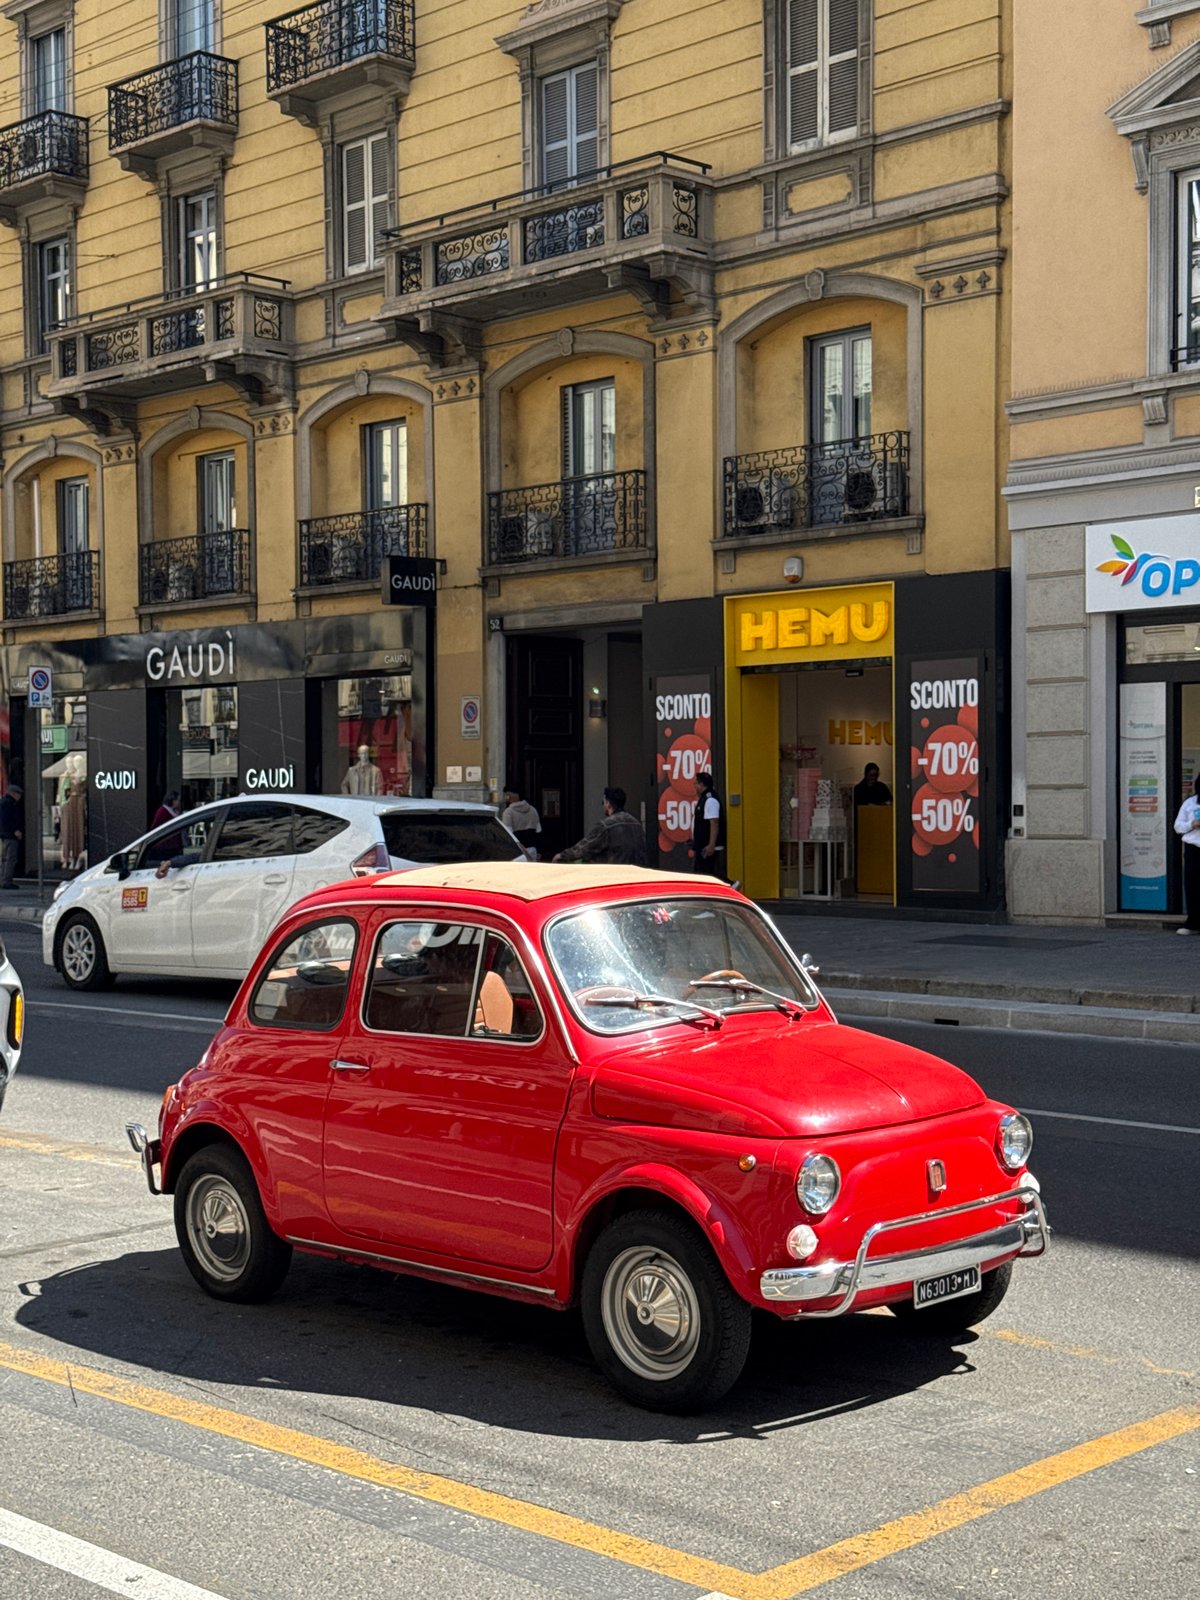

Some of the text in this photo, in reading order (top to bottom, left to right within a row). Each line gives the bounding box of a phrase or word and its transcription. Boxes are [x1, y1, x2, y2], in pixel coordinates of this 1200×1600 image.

[391, 572, 436, 591] GAUDÌ
[740, 600, 890, 652] HEMU
[146, 630, 234, 680] GAUDÌ
[656, 693, 711, 720] SCONTO
[910, 678, 978, 710] SCONTO
[917, 741, 979, 775] -70%
[658, 800, 698, 831] -50
[911, 798, 974, 832] -50%
